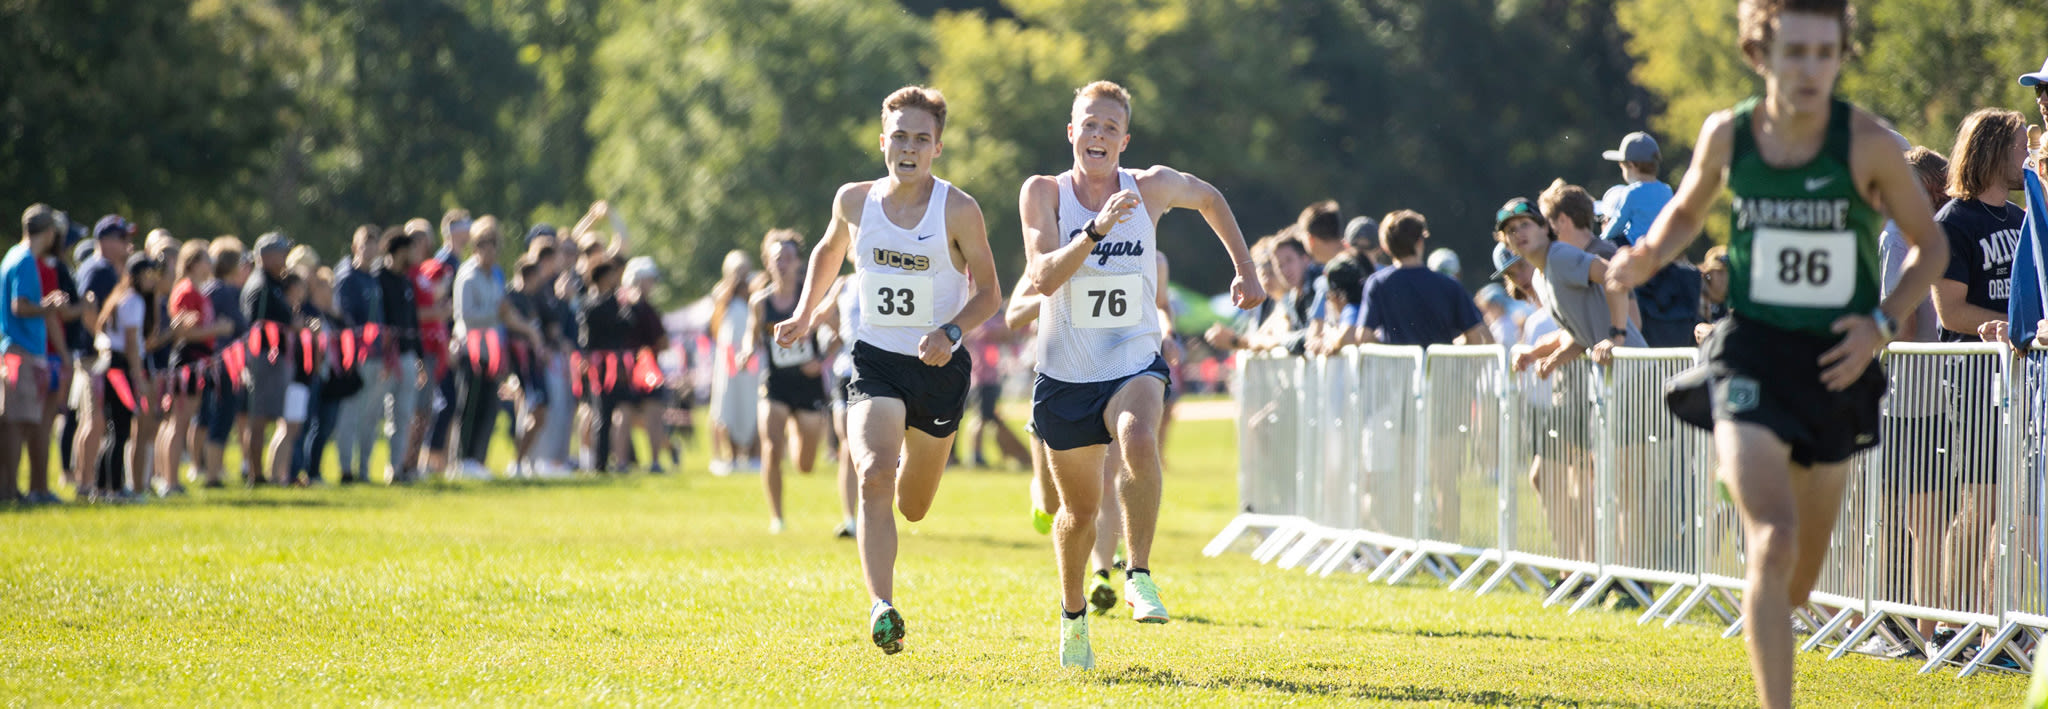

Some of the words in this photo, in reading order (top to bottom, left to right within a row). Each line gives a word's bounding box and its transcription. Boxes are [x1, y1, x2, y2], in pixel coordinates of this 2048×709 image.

[873, 247, 930, 271] UCCS
[1979, 228, 2021, 271] MIN
[1778, 247, 1832, 287] 86
[877, 286, 915, 316] 33
[1087, 288, 1128, 318] 76
